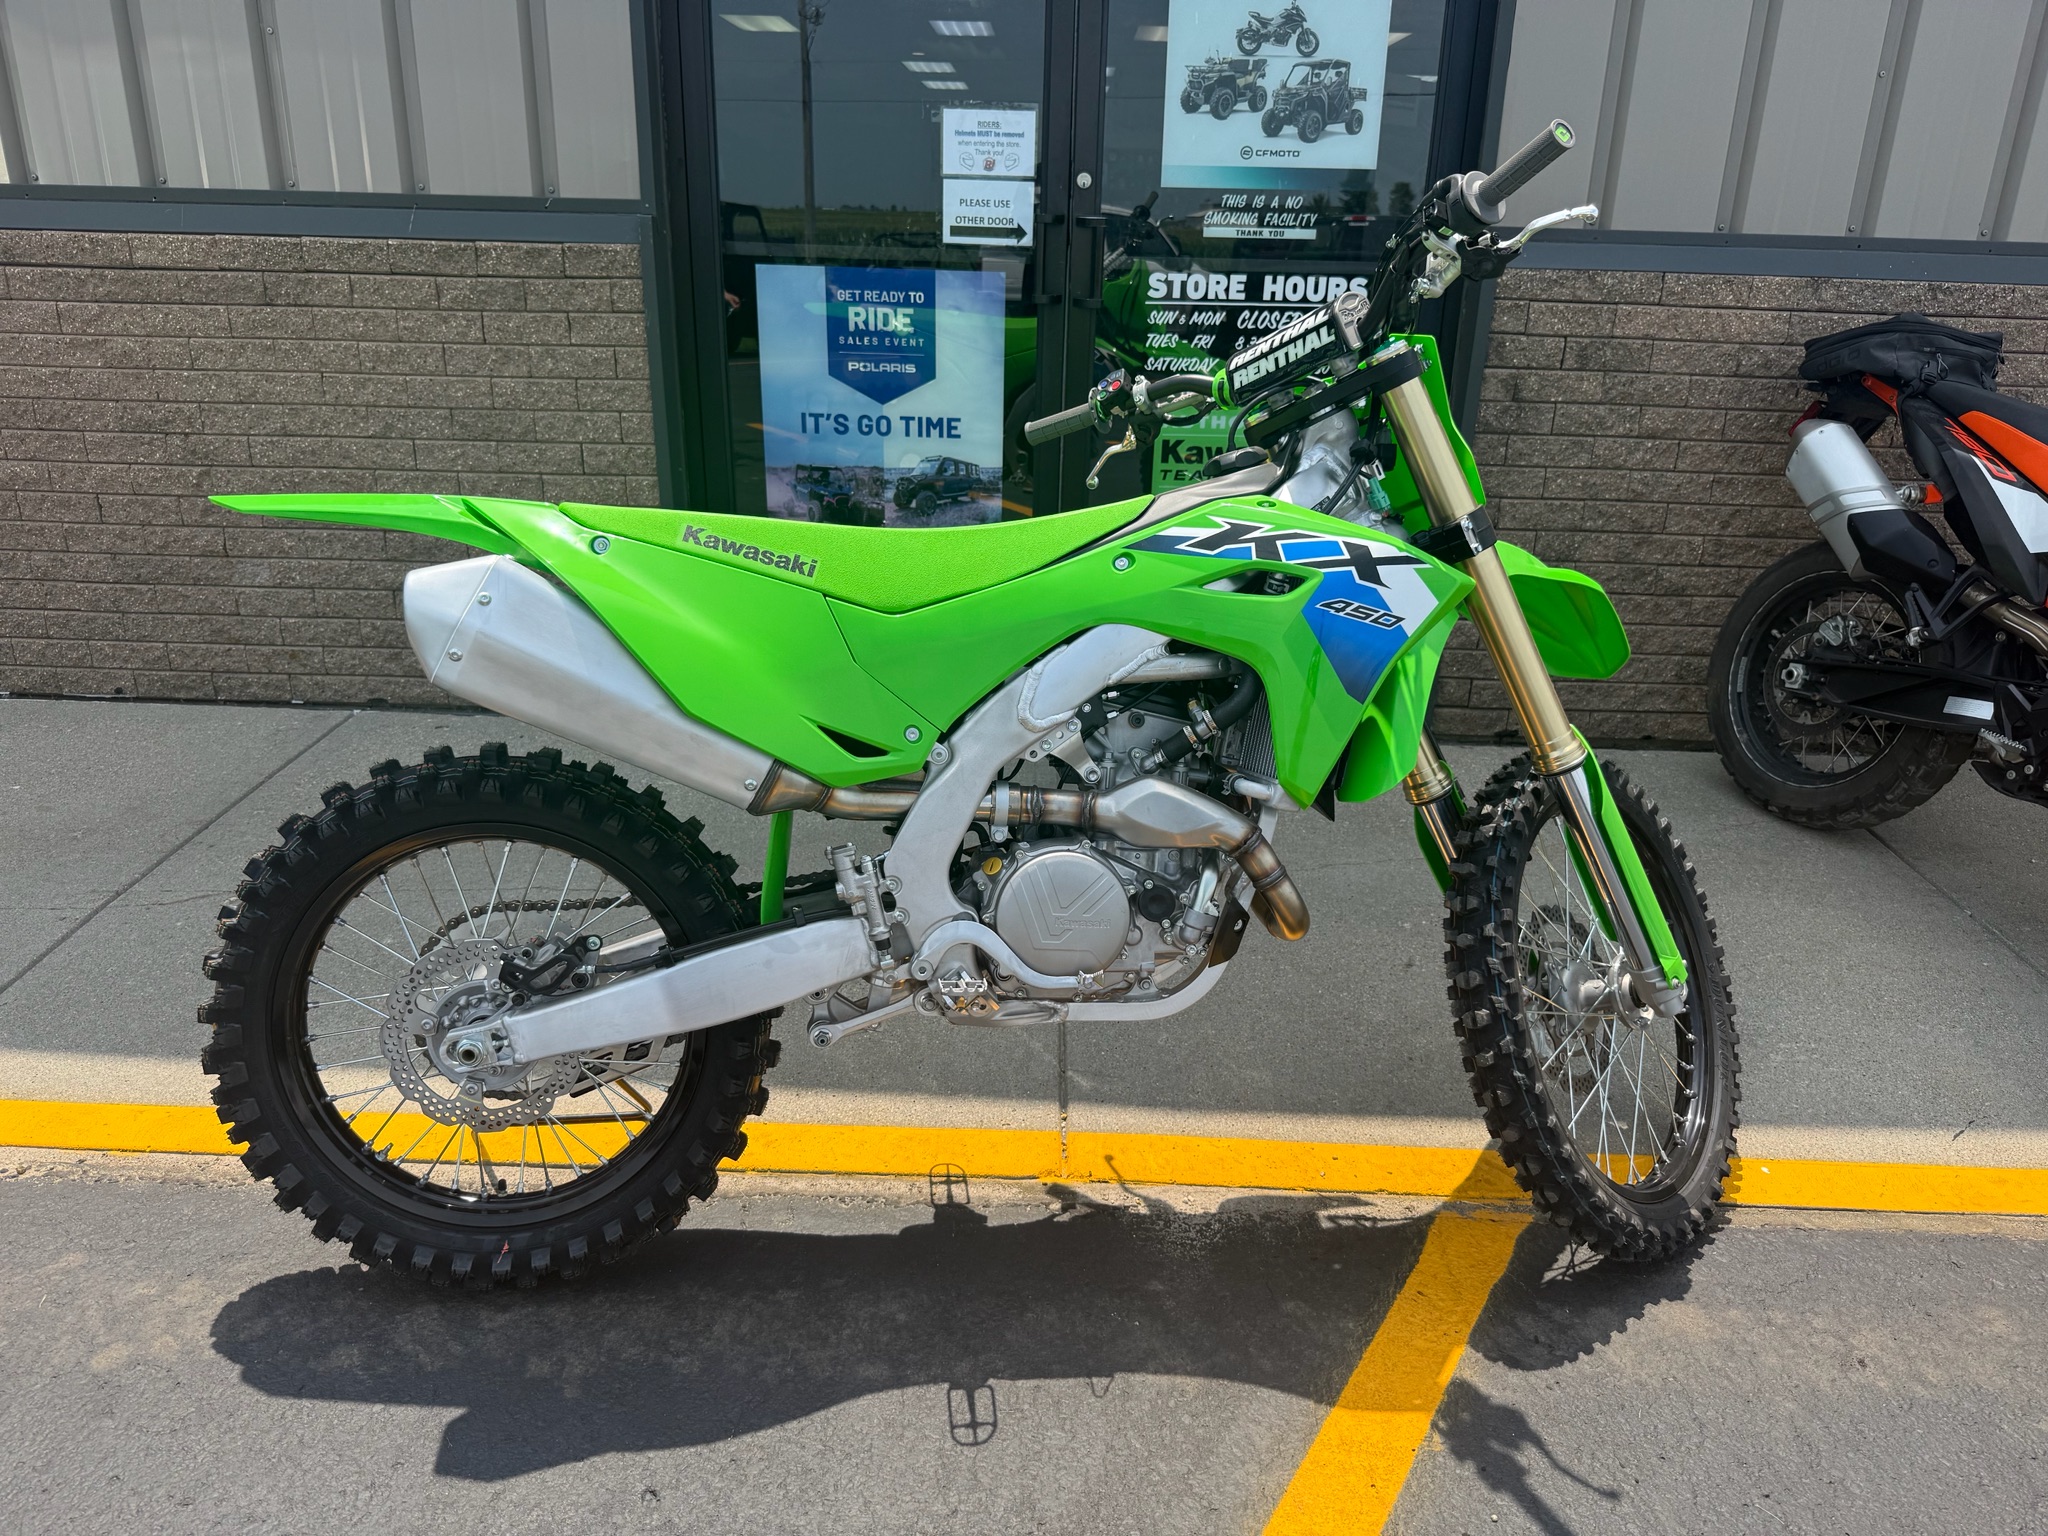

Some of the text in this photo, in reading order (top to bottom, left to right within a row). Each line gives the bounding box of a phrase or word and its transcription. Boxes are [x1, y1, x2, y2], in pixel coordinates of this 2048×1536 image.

[977, 130, 992, 138] MUST
[973, 140, 995, 148] entering
[1255, 149, 1301, 158] CFMOTO
[959, 198, 1011, 209] PLEASE USE
[1221, 194, 1303, 210] THIS IS A NO
[955, 215, 1014, 226] OTHER DOOR
[1203, 210, 1318, 227] SMOKING FACILITY
[1235, 229, 1285, 238] THANK YOU
[1146, 272, 1369, 303] STORE HOURS
[837, 290, 925, 303] GET READY TO
[848, 306, 915, 334] RIDE
[1147, 310, 1179, 326] SUN
[1189, 311, 1226, 326] MON
[838, 336, 925, 347] SALES EVENT
[1145, 333, 1179, 348] TUES
[1191, 334, 1217, 349] FRI
[1228, 308, 1330, 371] RENTHAL
[1144, 357, 1220, 372] SATURDAY
[1232, 325, 1336, 391] RENTHAL
[848, 362, 916, 374] POLARIS
[800, 412, 962, 439] IT'S GO TIME
[681, 524, 819, 578] Kawasaki
[1315, 598, 1406, 631] 450
[1054, 916, 1112, 930] Kawasaki
